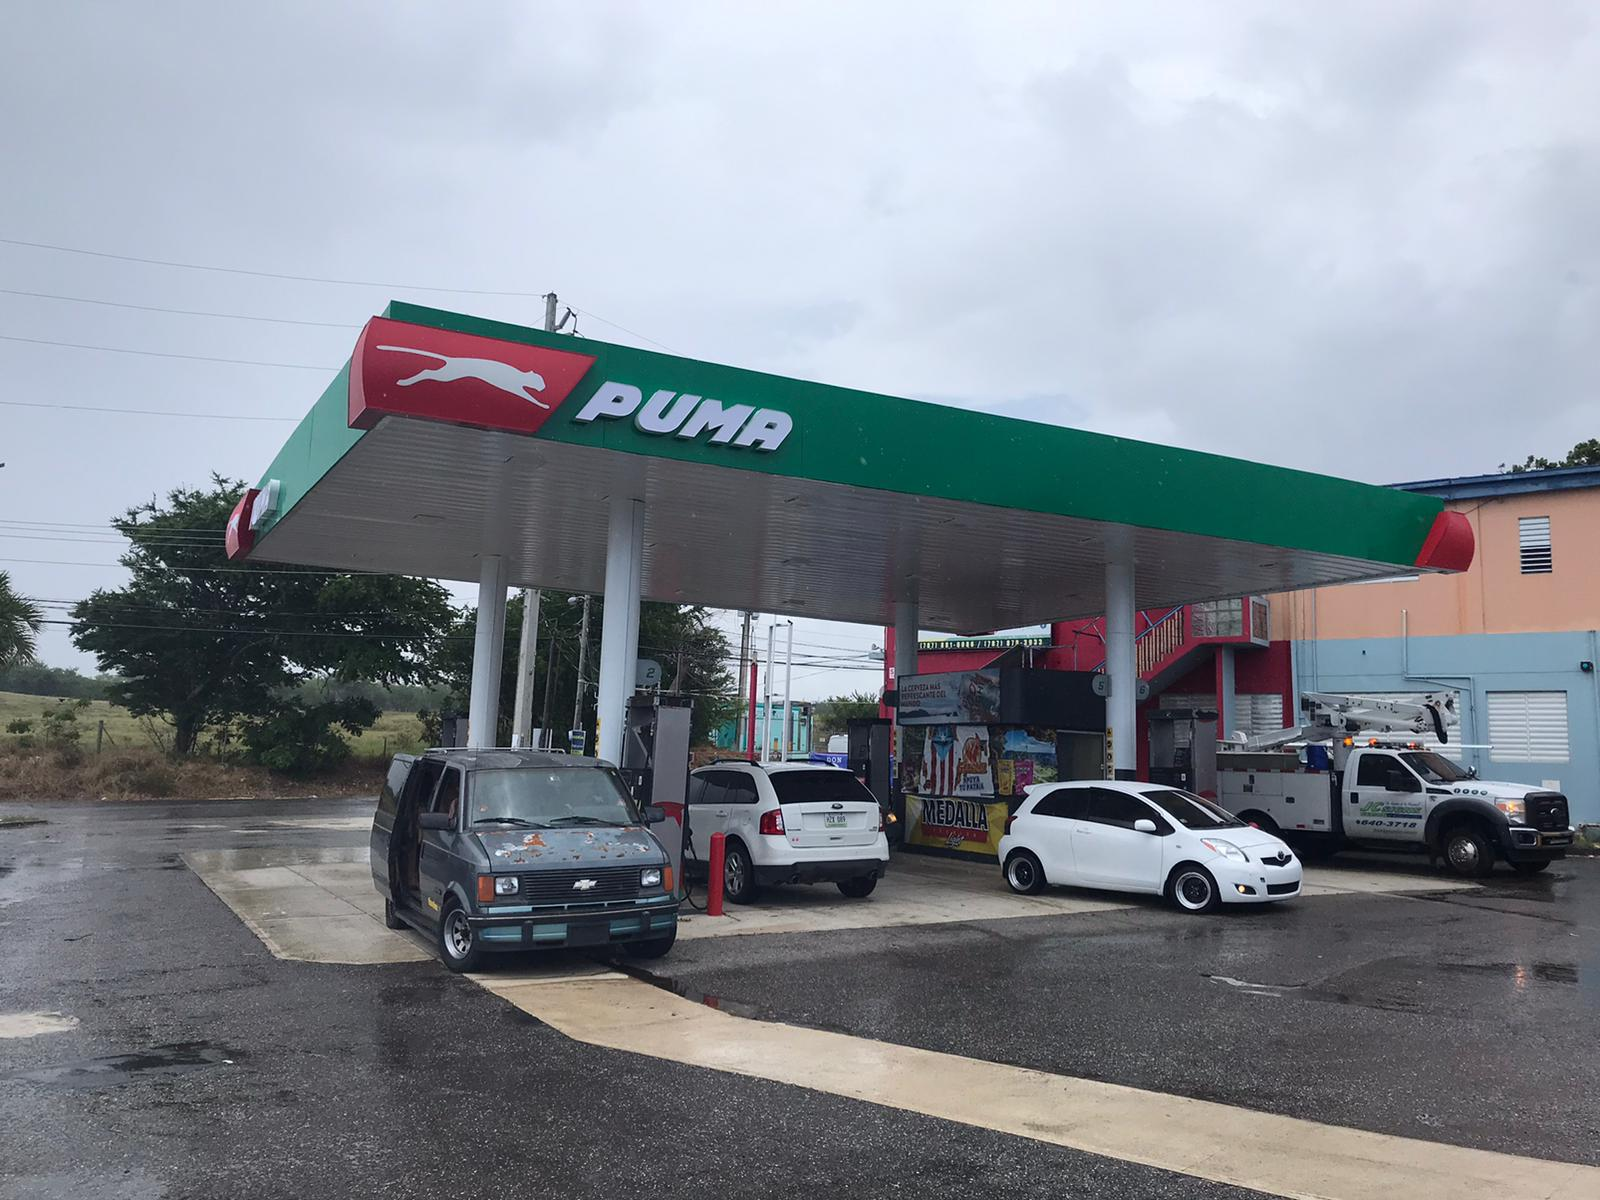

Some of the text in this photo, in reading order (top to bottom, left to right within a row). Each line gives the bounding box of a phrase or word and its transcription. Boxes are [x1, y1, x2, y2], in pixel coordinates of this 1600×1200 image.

[575, 380, 794, 451] PUMA
[646, 667, 656, 679] 2
[908, 684, 929, 692] CERVEZA
[1098, 681, 1105, 691] 5
[1139, 684, 1146, 695] 6
[922, 799, 989, 831] MEDALLA
